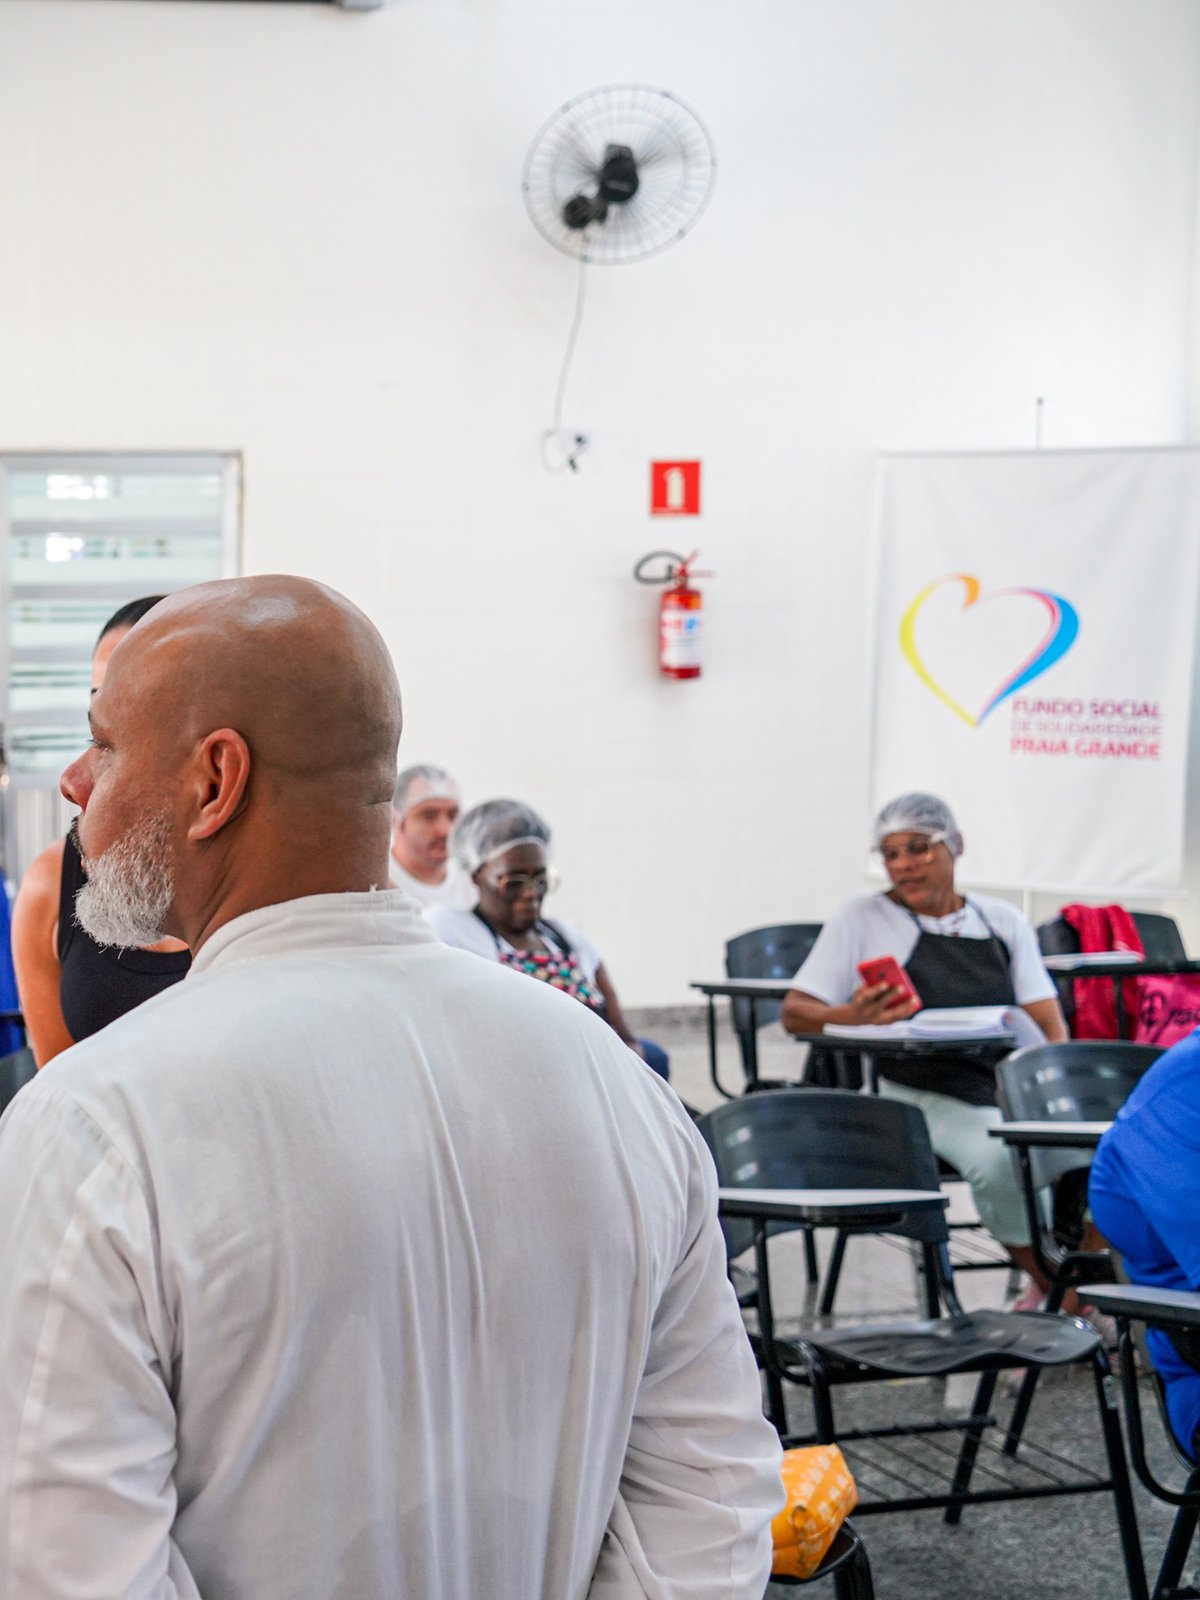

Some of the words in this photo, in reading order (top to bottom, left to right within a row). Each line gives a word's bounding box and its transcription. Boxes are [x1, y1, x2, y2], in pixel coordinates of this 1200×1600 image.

[1012, 698, 1084, 717] FUNDO
[1089, 699, 1160, 719] SOCIAL
[1010, 736, 1070, 755] PRAIA
[1073, 738, 1161, 760] GRANDE
